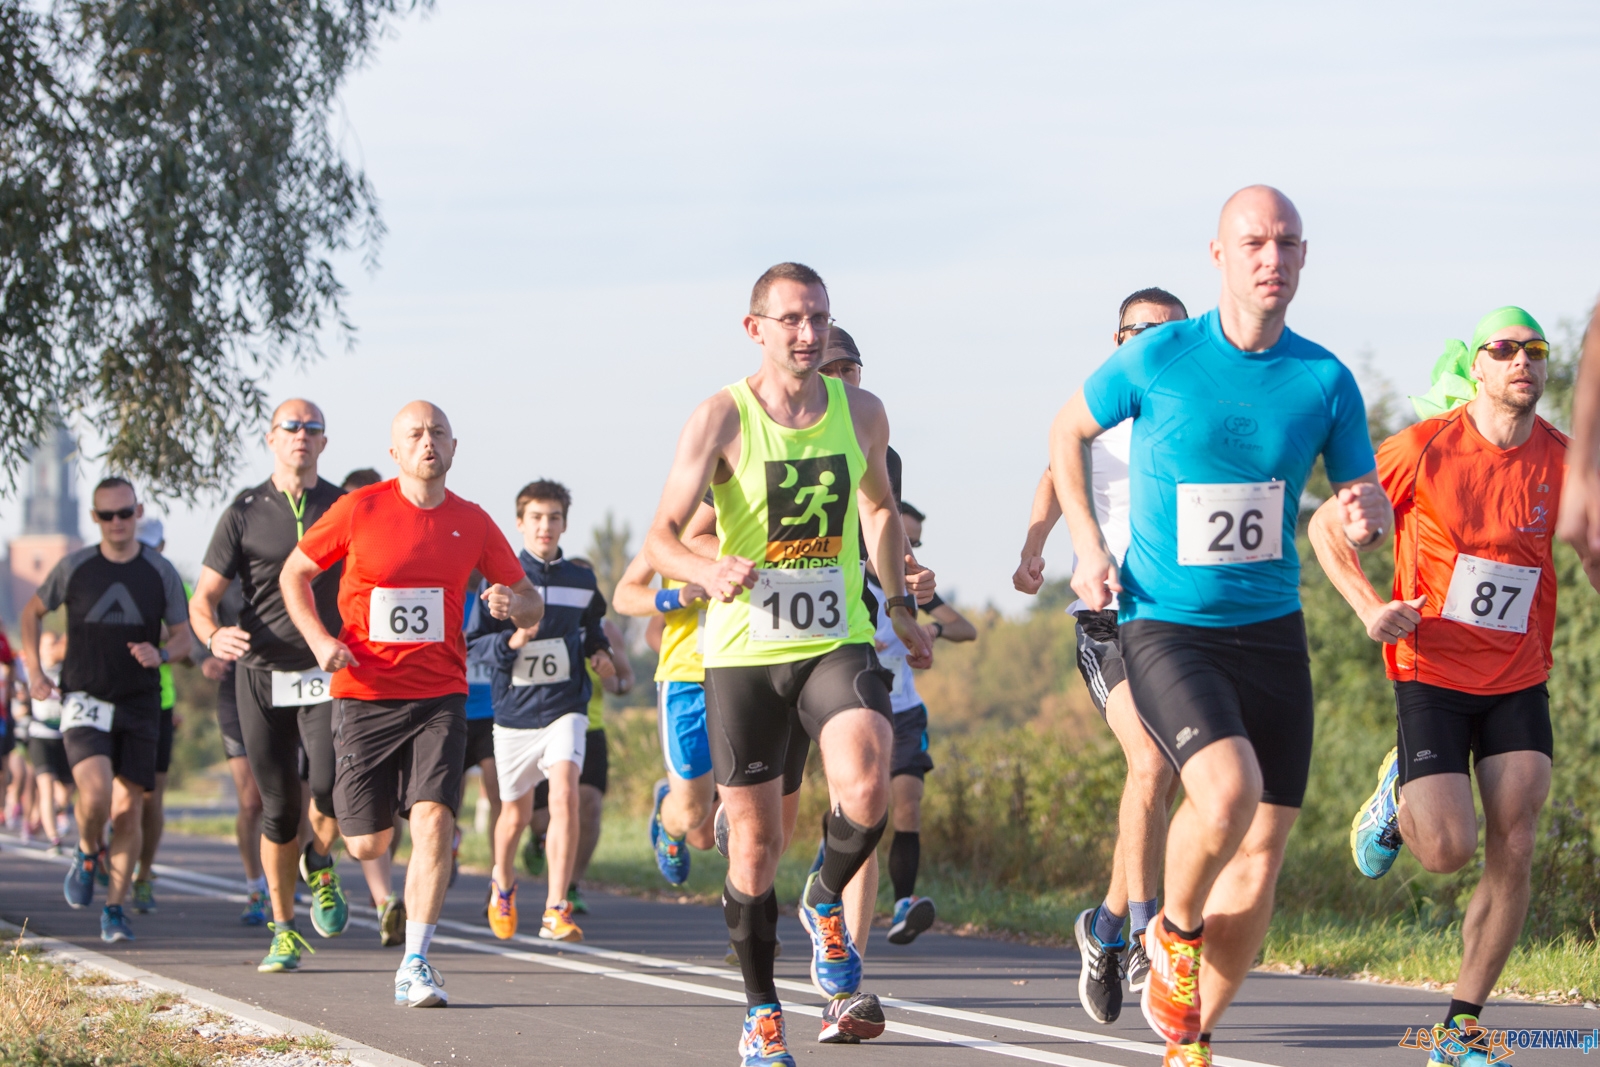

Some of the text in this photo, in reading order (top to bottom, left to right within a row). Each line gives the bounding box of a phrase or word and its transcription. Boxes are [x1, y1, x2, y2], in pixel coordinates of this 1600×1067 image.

[1208, 509, 1264, 552] 26
[763, 590, 840, 630] 103
[1471, 581, 1522, 620] 87
[390, 605, 429, 635] 63
[524, 653, 557, 677] 76
[291, 677, 324, 699] 18
[72, 702, 99, 722] 24
